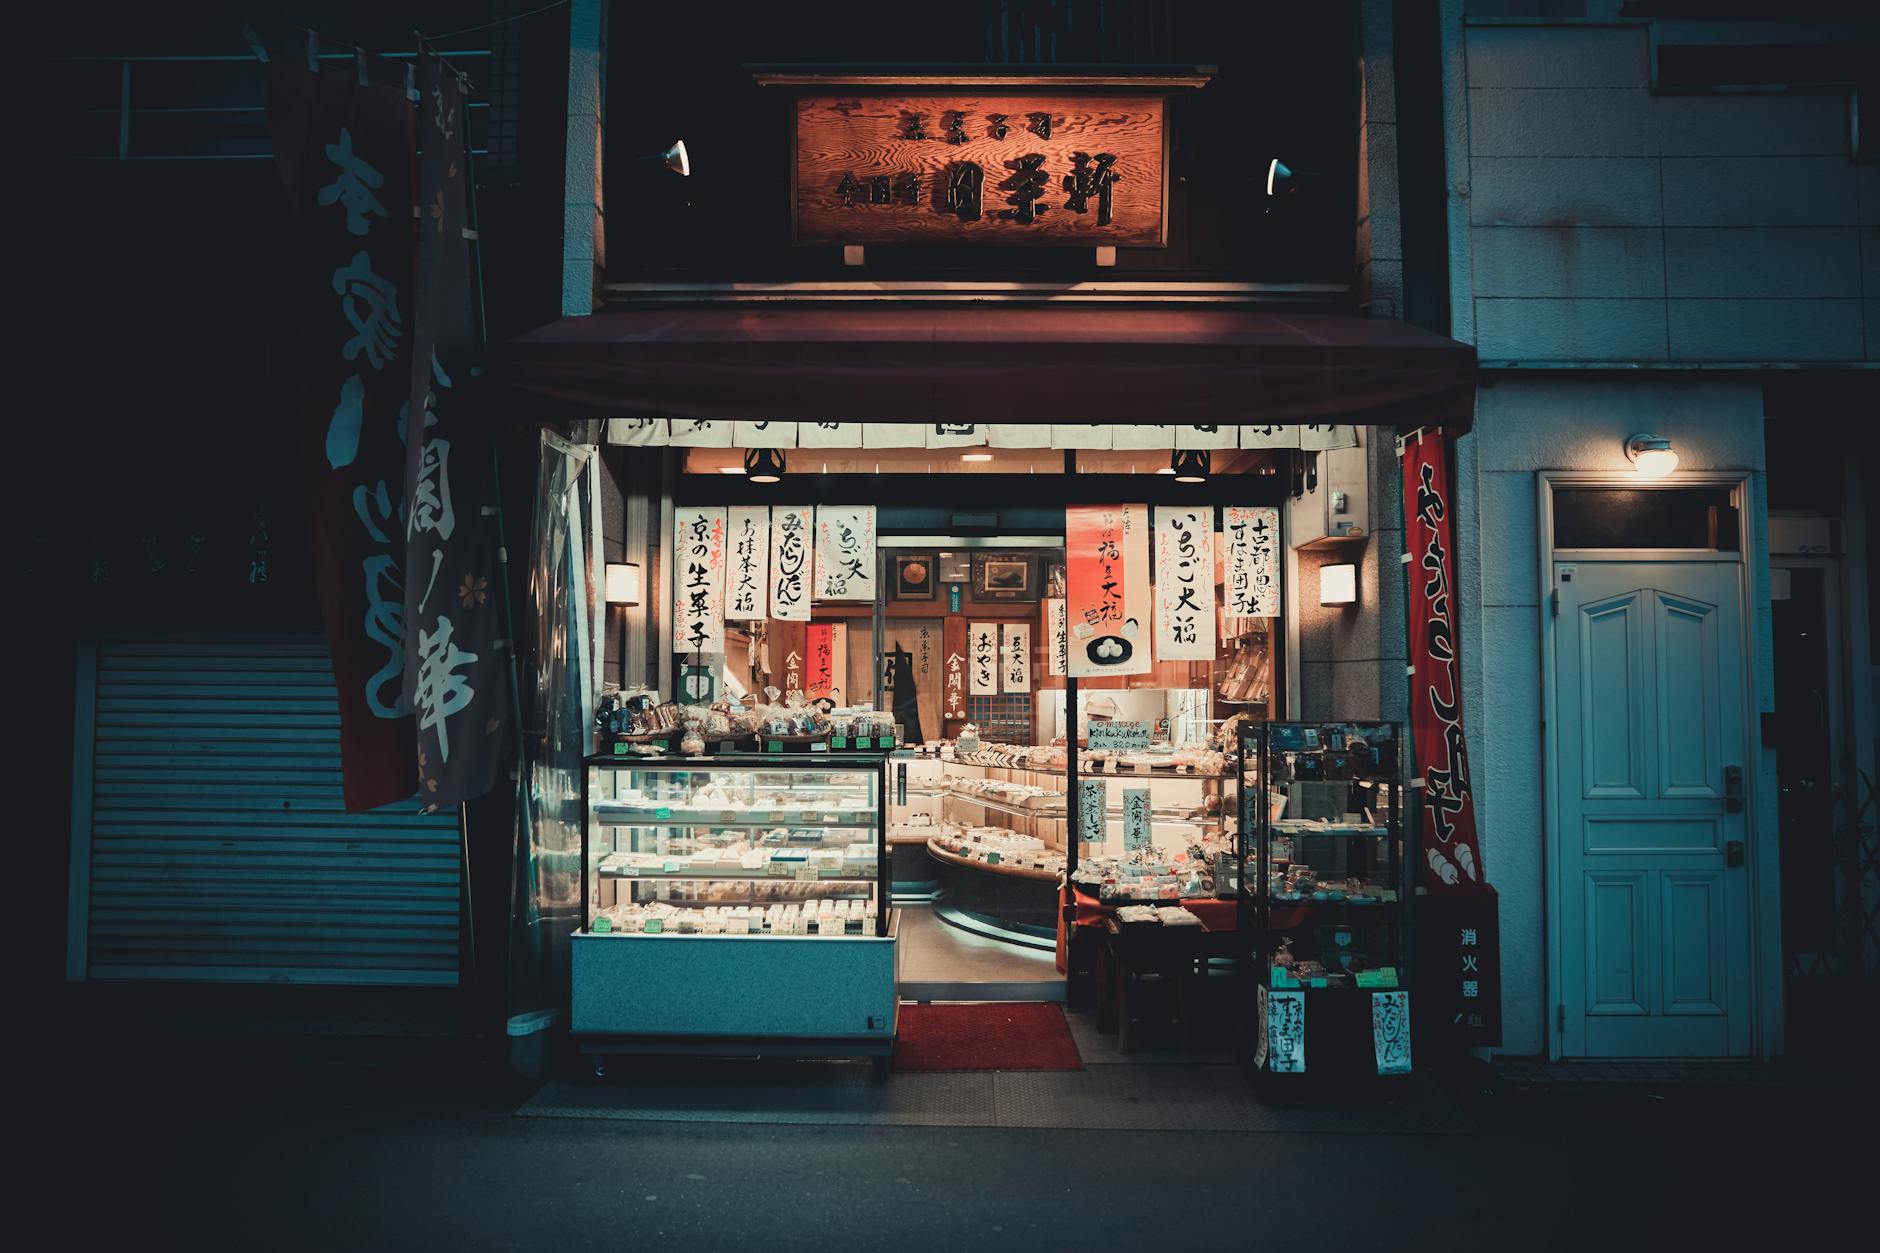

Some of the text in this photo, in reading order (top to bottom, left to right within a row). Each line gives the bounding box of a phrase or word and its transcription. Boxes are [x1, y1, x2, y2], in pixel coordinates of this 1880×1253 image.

[687, 513, 711, 650] 京の生菓子
[734, 518, 758, 613] お抹茶大福
[776, 512, 805, 617] みたらしだんご
[824, 515, 870, 597] いちご大福
[1171, 513, 1202, 645] いちご大福
[976, 632, 992, 687] おやき
[1010, 636, 1024, 684] 豆大福
[1460, 928, 1479, 998] 消火器
